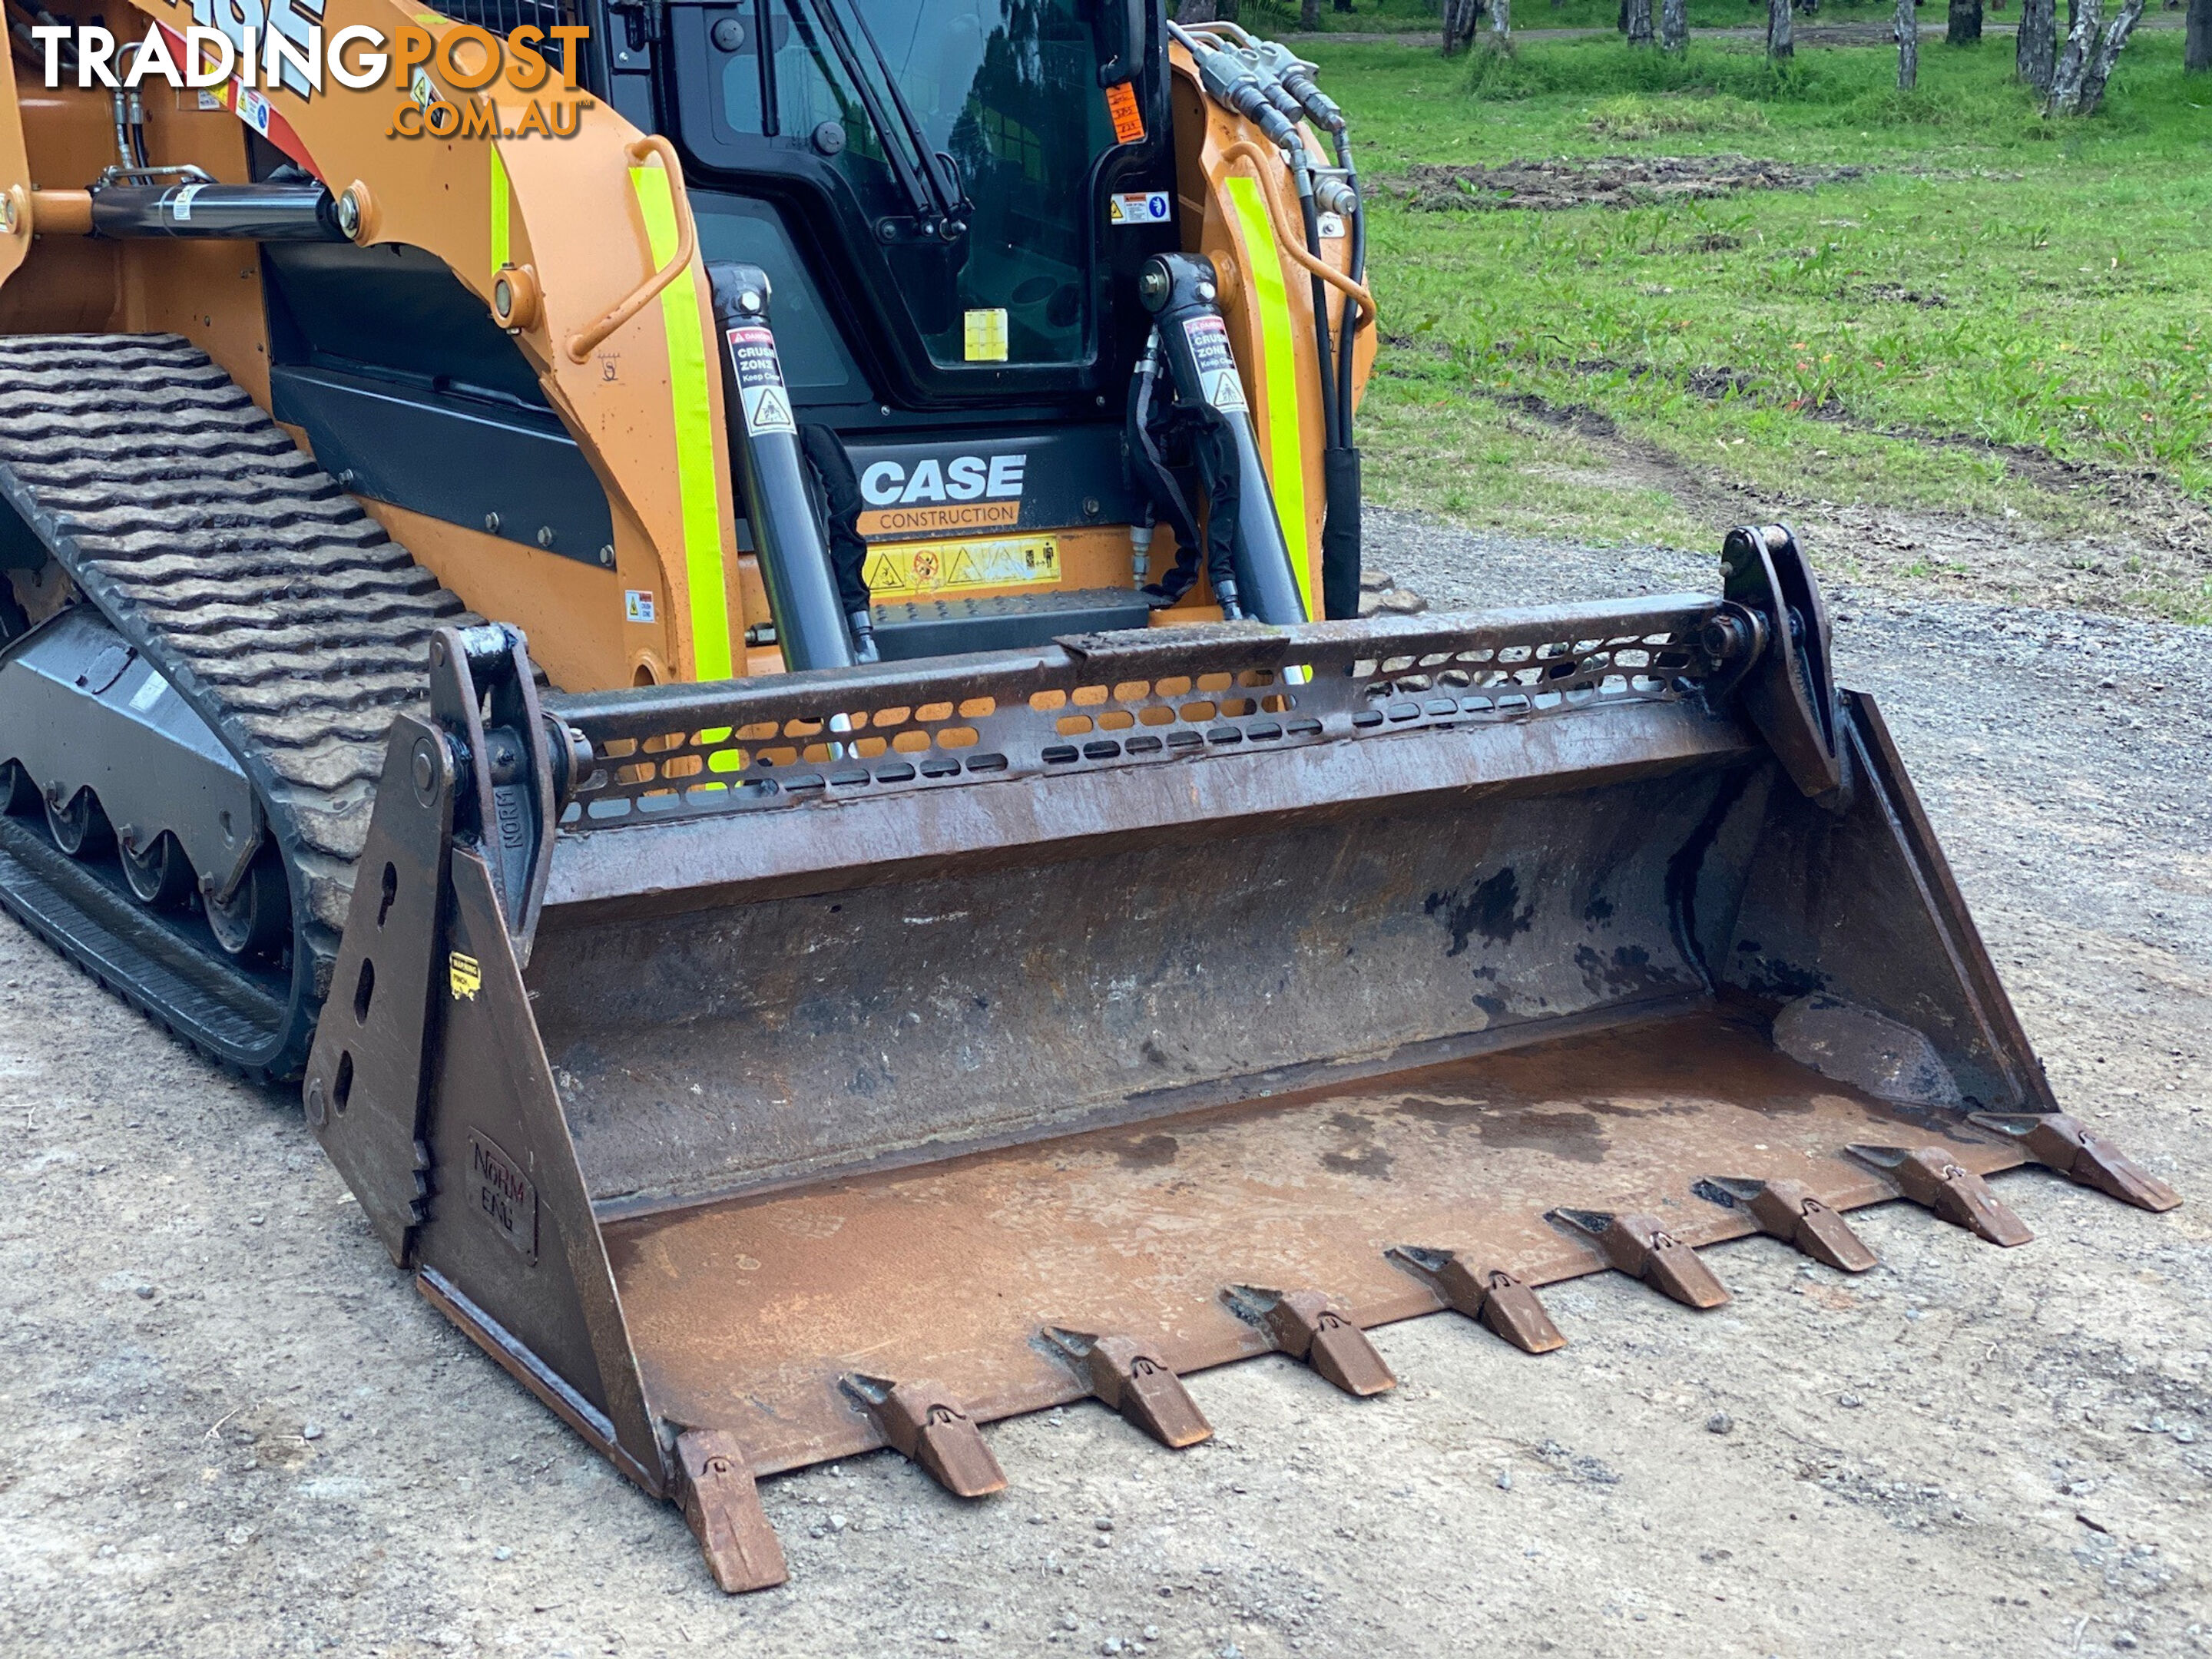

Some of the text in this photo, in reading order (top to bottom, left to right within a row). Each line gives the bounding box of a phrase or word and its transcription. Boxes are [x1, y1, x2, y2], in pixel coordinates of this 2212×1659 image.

[1197, 345, 1227, 357] ZONE
[740, 360, 773, 371] ZONE
[743, 373, 763, 382] Keep
[860, 455, 1027, 505] CASE
[880, 506, 1014, 529] CONSTRUCTION
[495, 790, 524, 849] NORM
